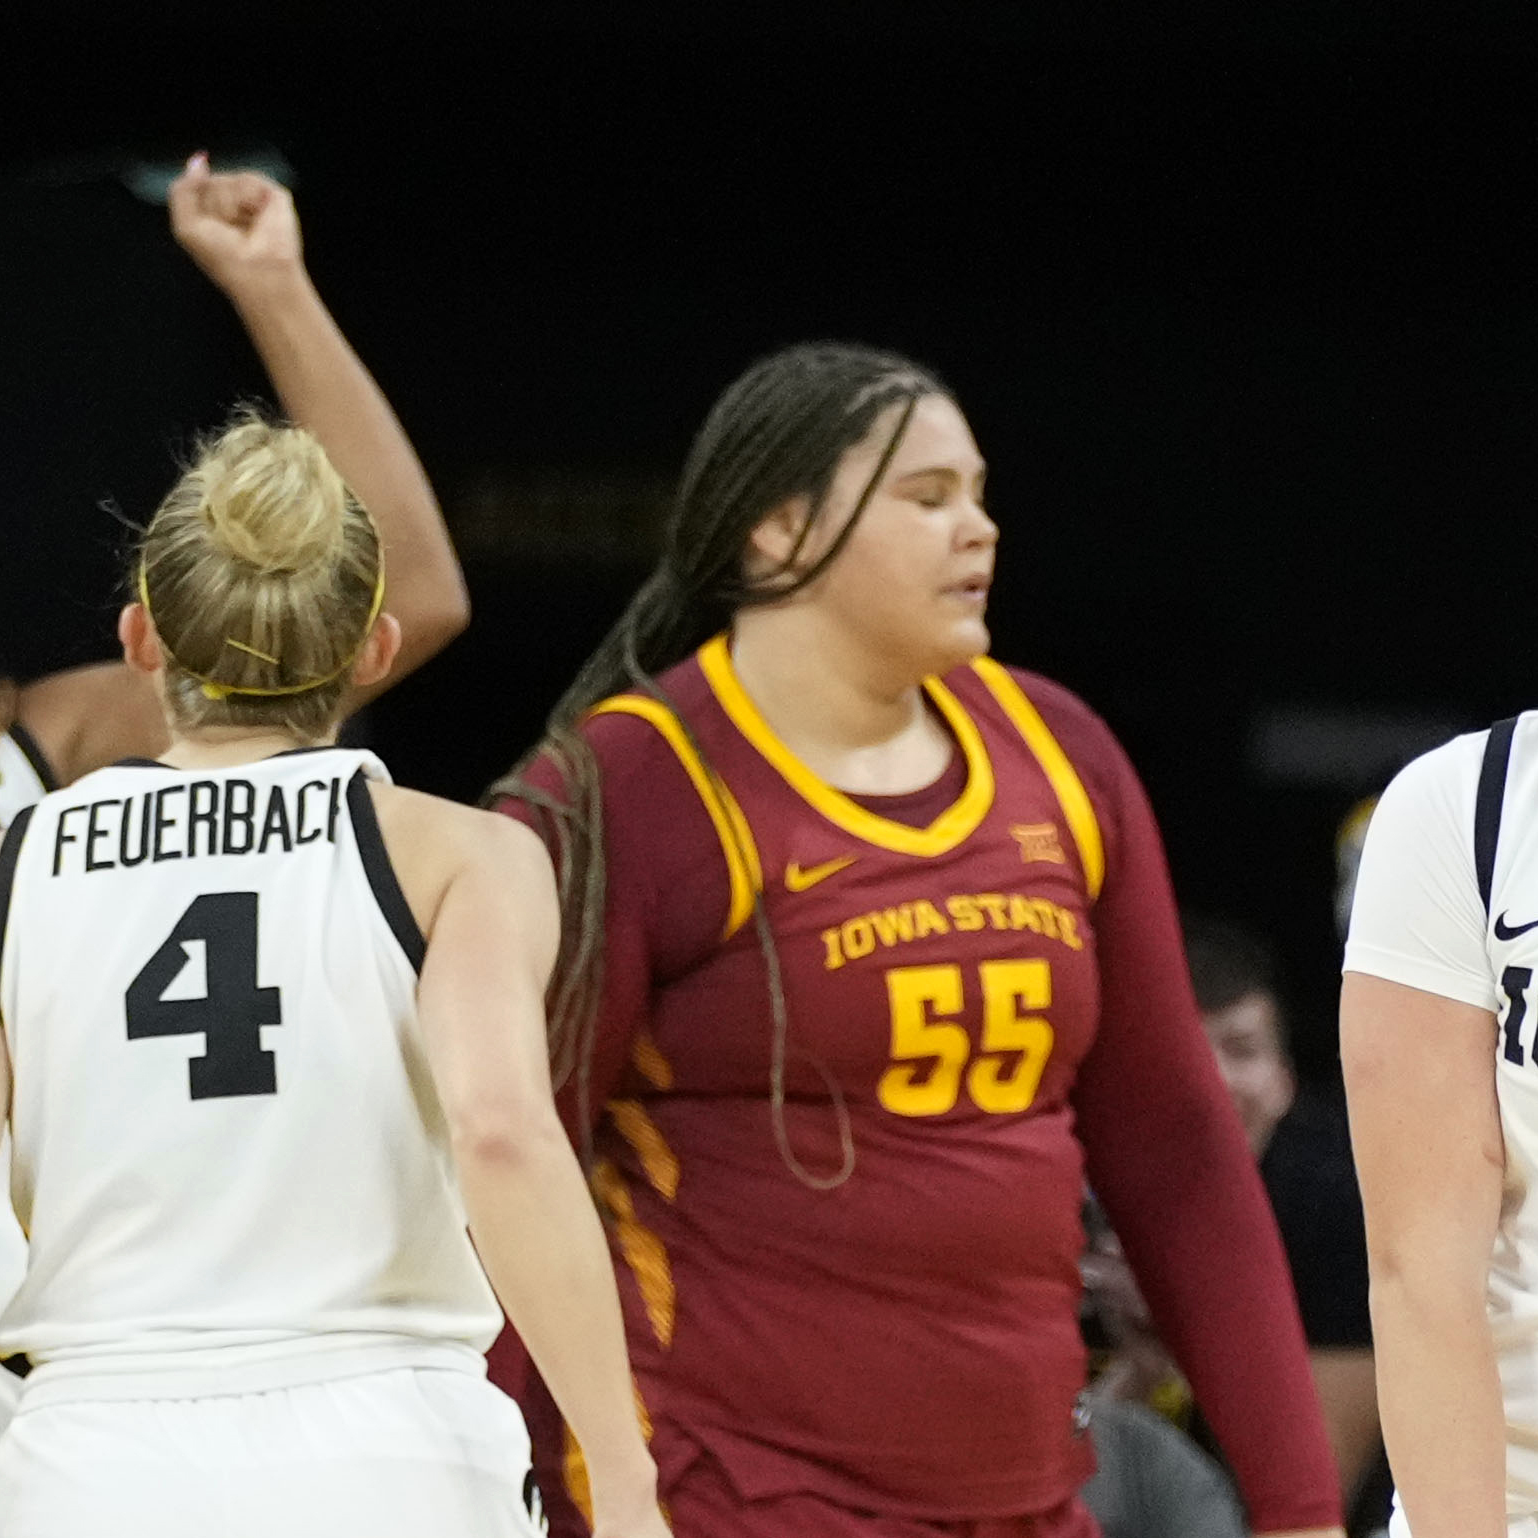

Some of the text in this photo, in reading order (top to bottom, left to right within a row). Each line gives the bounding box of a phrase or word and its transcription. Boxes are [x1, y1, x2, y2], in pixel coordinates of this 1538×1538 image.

[124, 891, 282, 1101] 4
[820, 892, 1085, 971] IOWA STATE
[876, 956, 1055, 1117] 55
